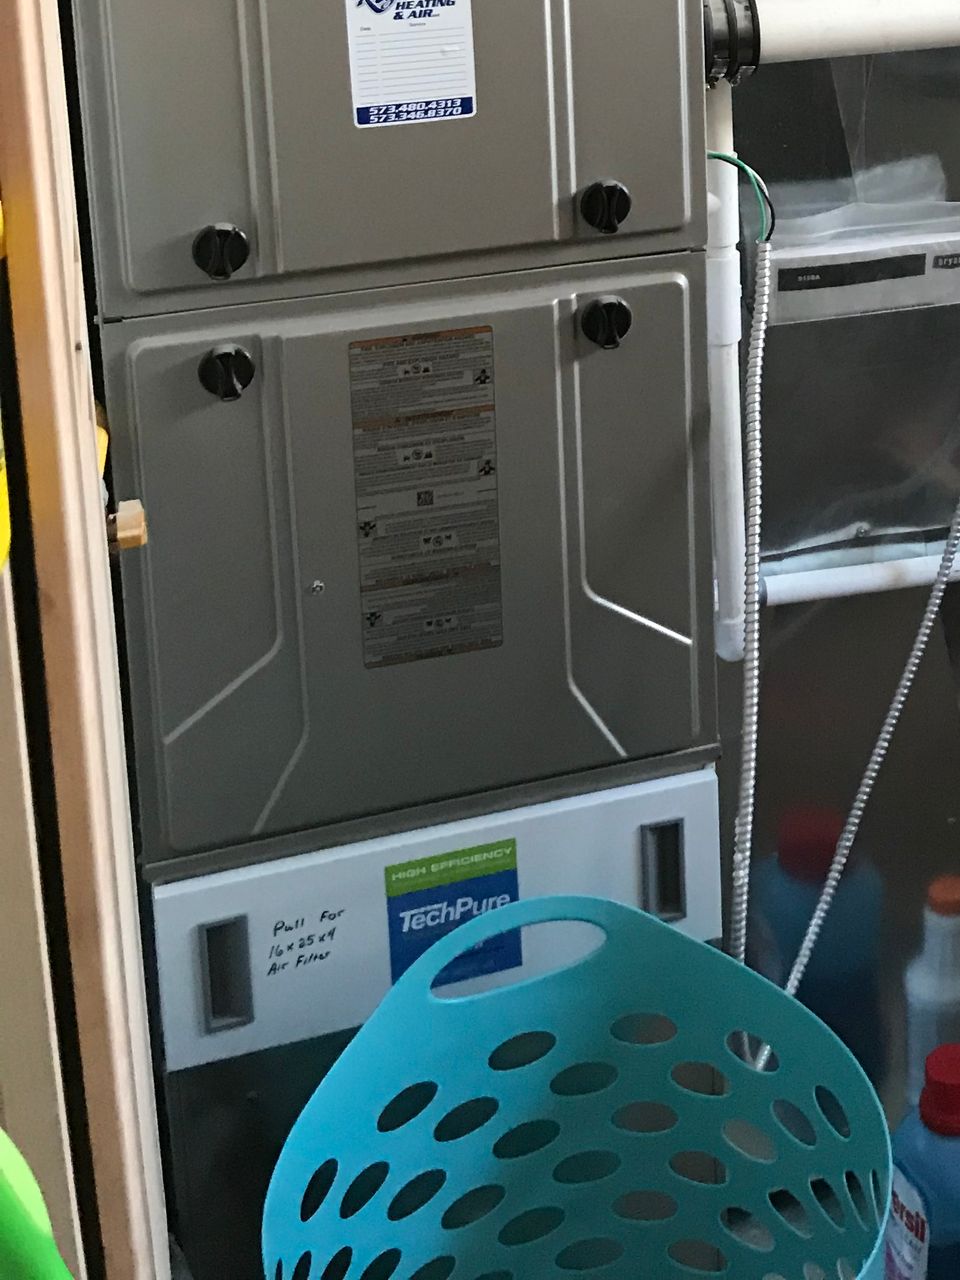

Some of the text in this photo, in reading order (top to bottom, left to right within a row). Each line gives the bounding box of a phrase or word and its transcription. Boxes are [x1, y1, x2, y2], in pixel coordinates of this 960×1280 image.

[393, 9, 433, 20] & AIR
[369, 98, 462, 115] 573.480.4313
[369, 107, 462, 123] 573.346.8370
[391, 846, 513, 881] HIGH EFFICIENCY
[273, 909, 346, 937] Pull For
[399, 893, 511, 933] TechPure
[267, 950, 331, 976] Air Filter
[892, 1189, 926, 1244] ersil
